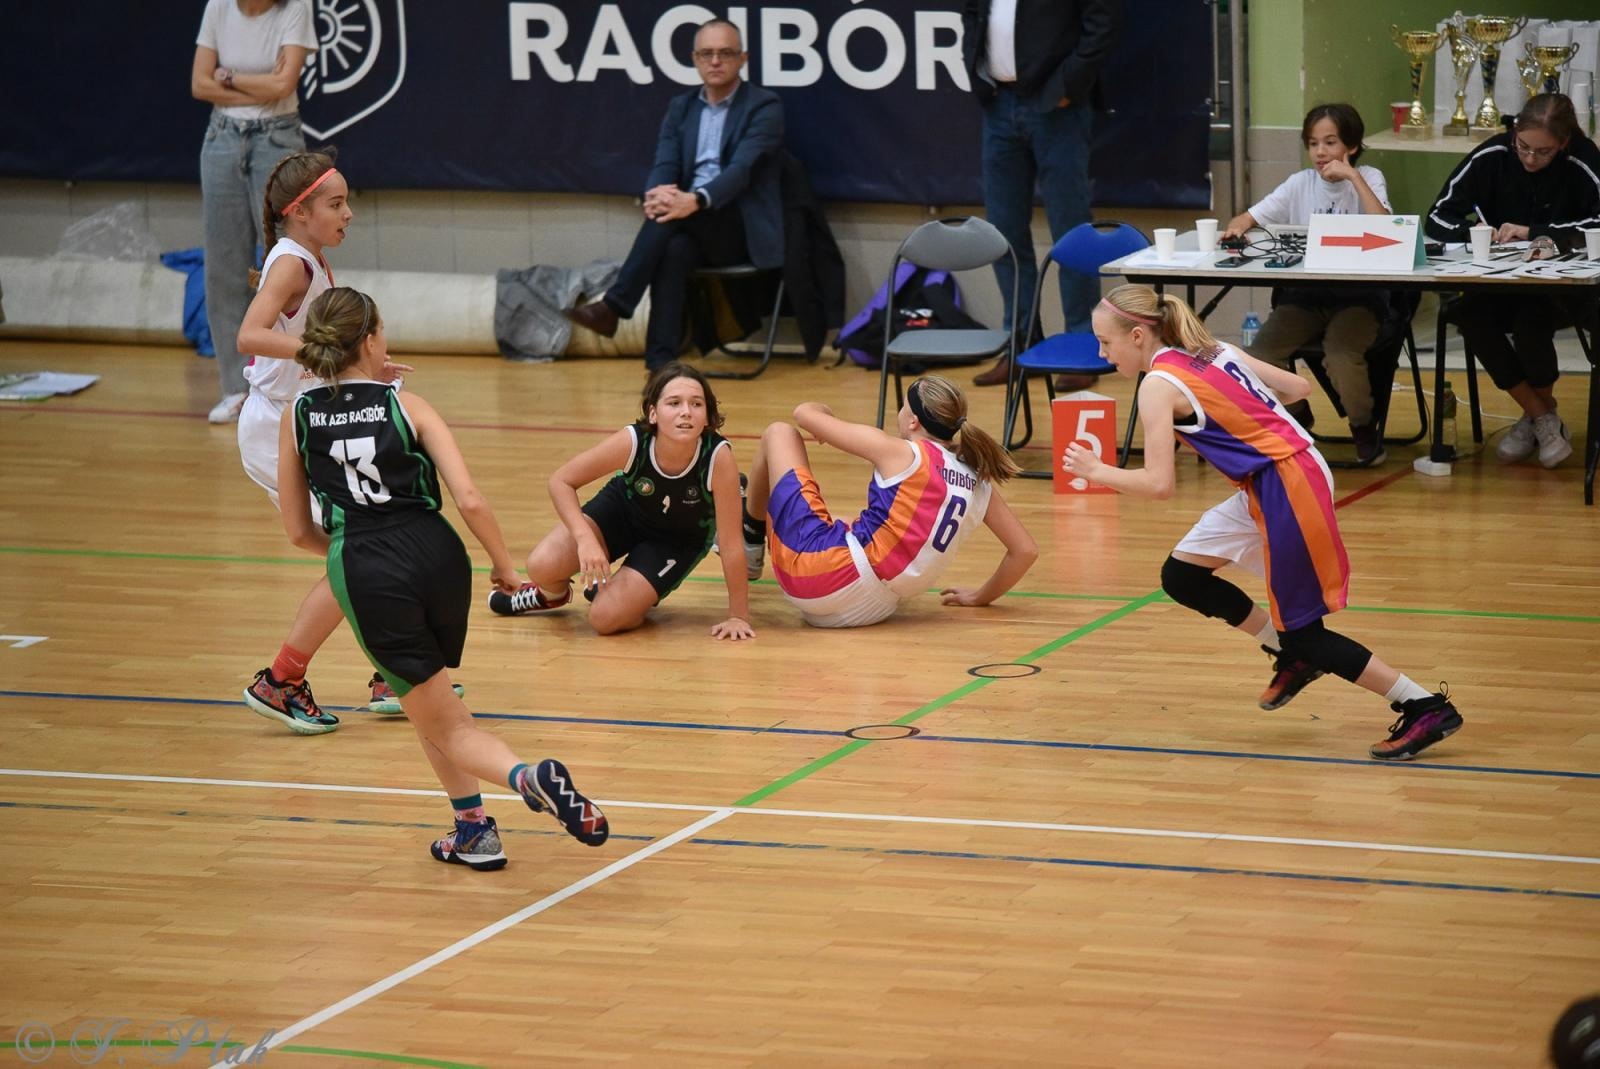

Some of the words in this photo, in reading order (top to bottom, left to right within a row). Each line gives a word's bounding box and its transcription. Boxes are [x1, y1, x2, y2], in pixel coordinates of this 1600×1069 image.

[1224, 361, 1277, 410] 2
[309, 412, 327, 427] RKK
[329, 413, 348, 426] AZS
[1075, 410, 1105, 460] 5
[329, 436, 392, 505] 13
[932, 495, 967, 553] 6
[657, 559, 677, 577] 1
